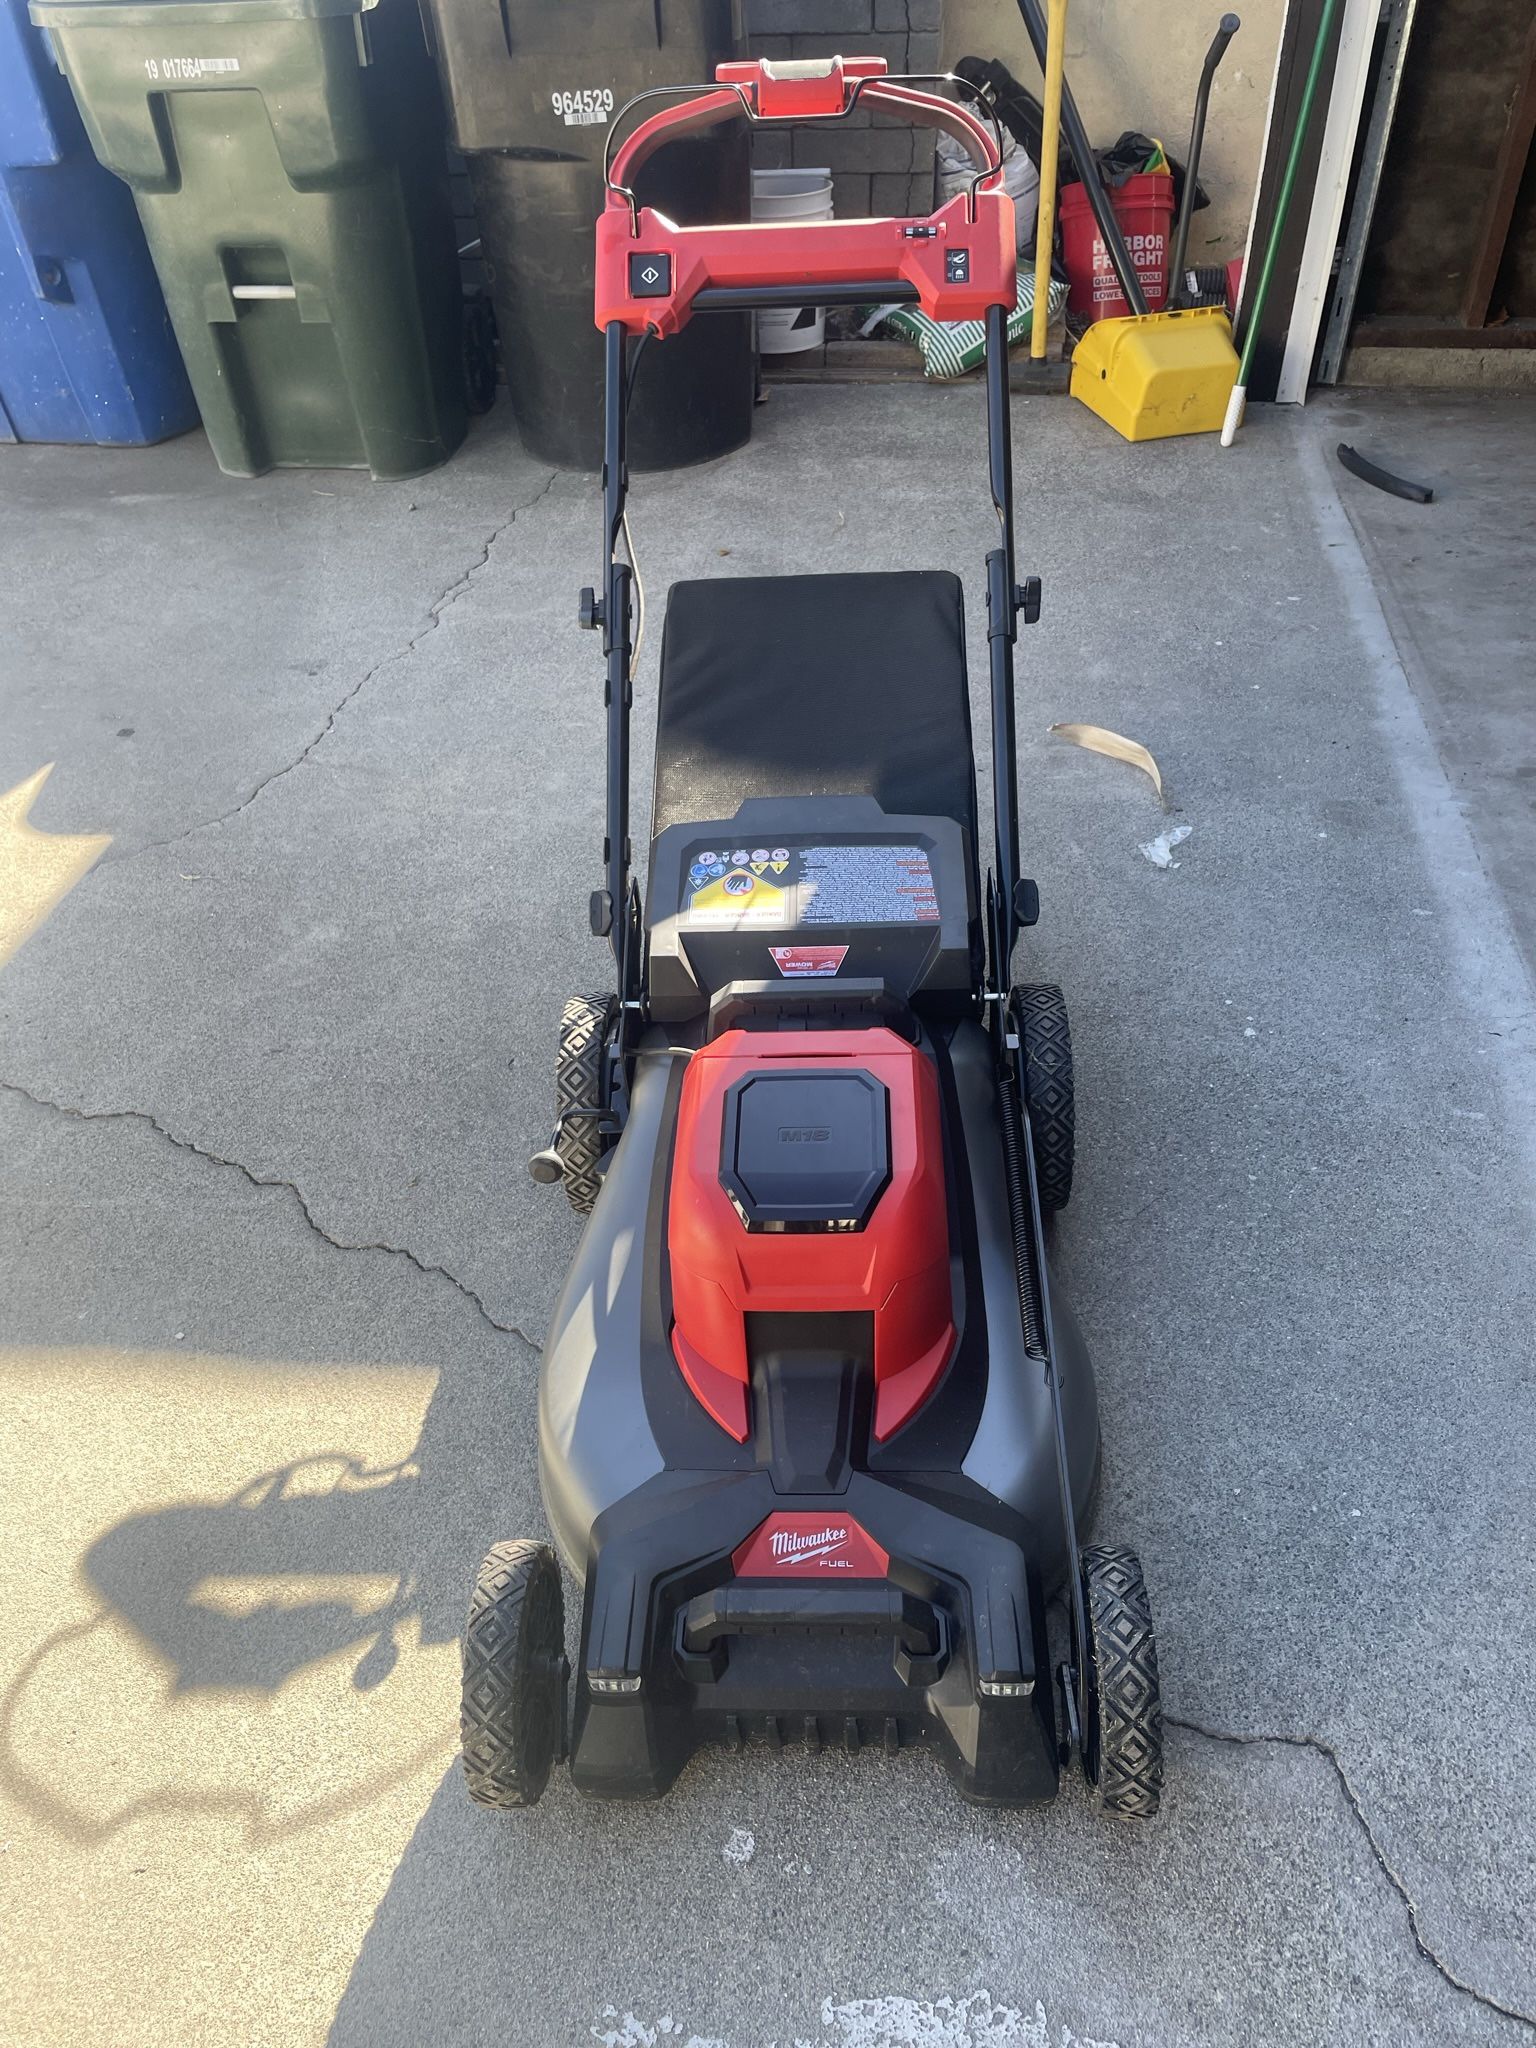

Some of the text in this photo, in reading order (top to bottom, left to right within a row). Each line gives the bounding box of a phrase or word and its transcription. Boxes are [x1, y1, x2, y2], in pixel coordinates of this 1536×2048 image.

[145, 57, 201, 79] 19 017664
[551, 88, 614, 115] 964529
[1093, 234, 1163, 255] HRBOR
[781, 1129, 830, 1142] M18
[769, 1527, 848, 1557] Milwaukee
[820, 1560, 854, 1568] FUEL
